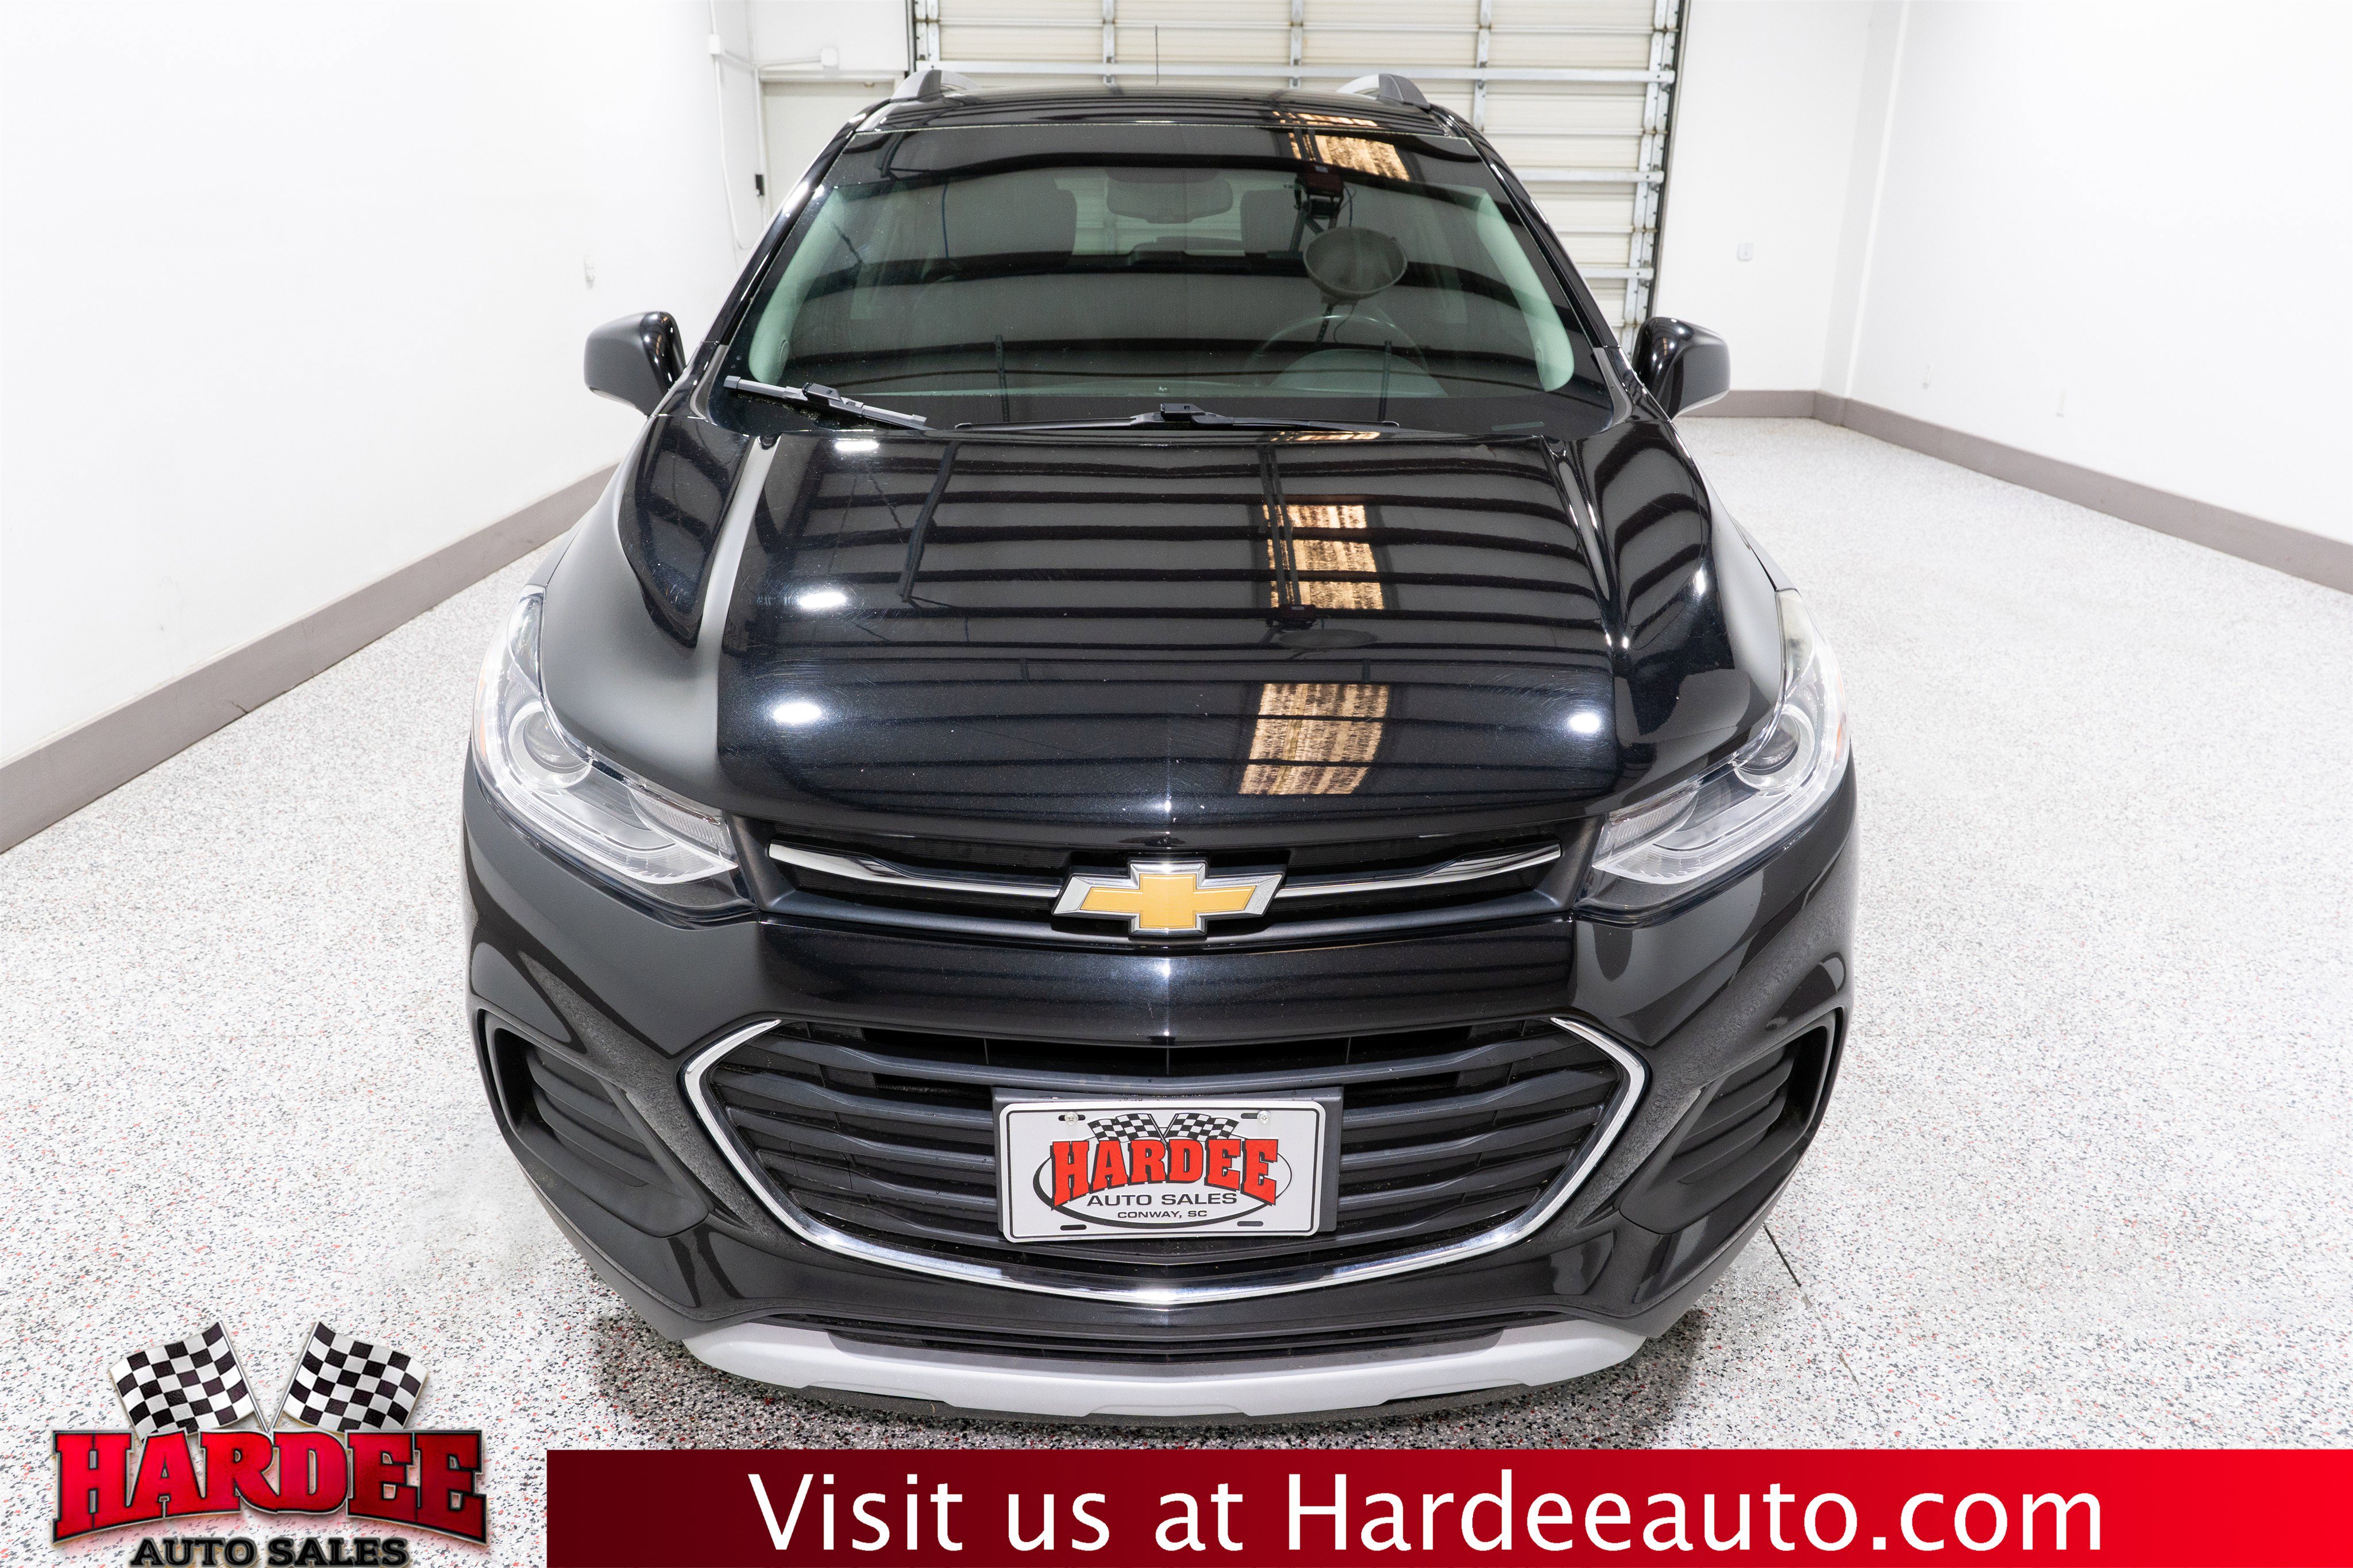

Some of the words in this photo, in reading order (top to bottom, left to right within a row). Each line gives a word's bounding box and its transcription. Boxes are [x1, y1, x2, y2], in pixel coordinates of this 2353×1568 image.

[1050, 1138, 1279, 1210] HARDEE
[1086, 1195, 1152, 1207] AUTO
[1161, 1192, 1237, 1206] SALES
[1117, 1210, 1182, 1219] CONWAY,
